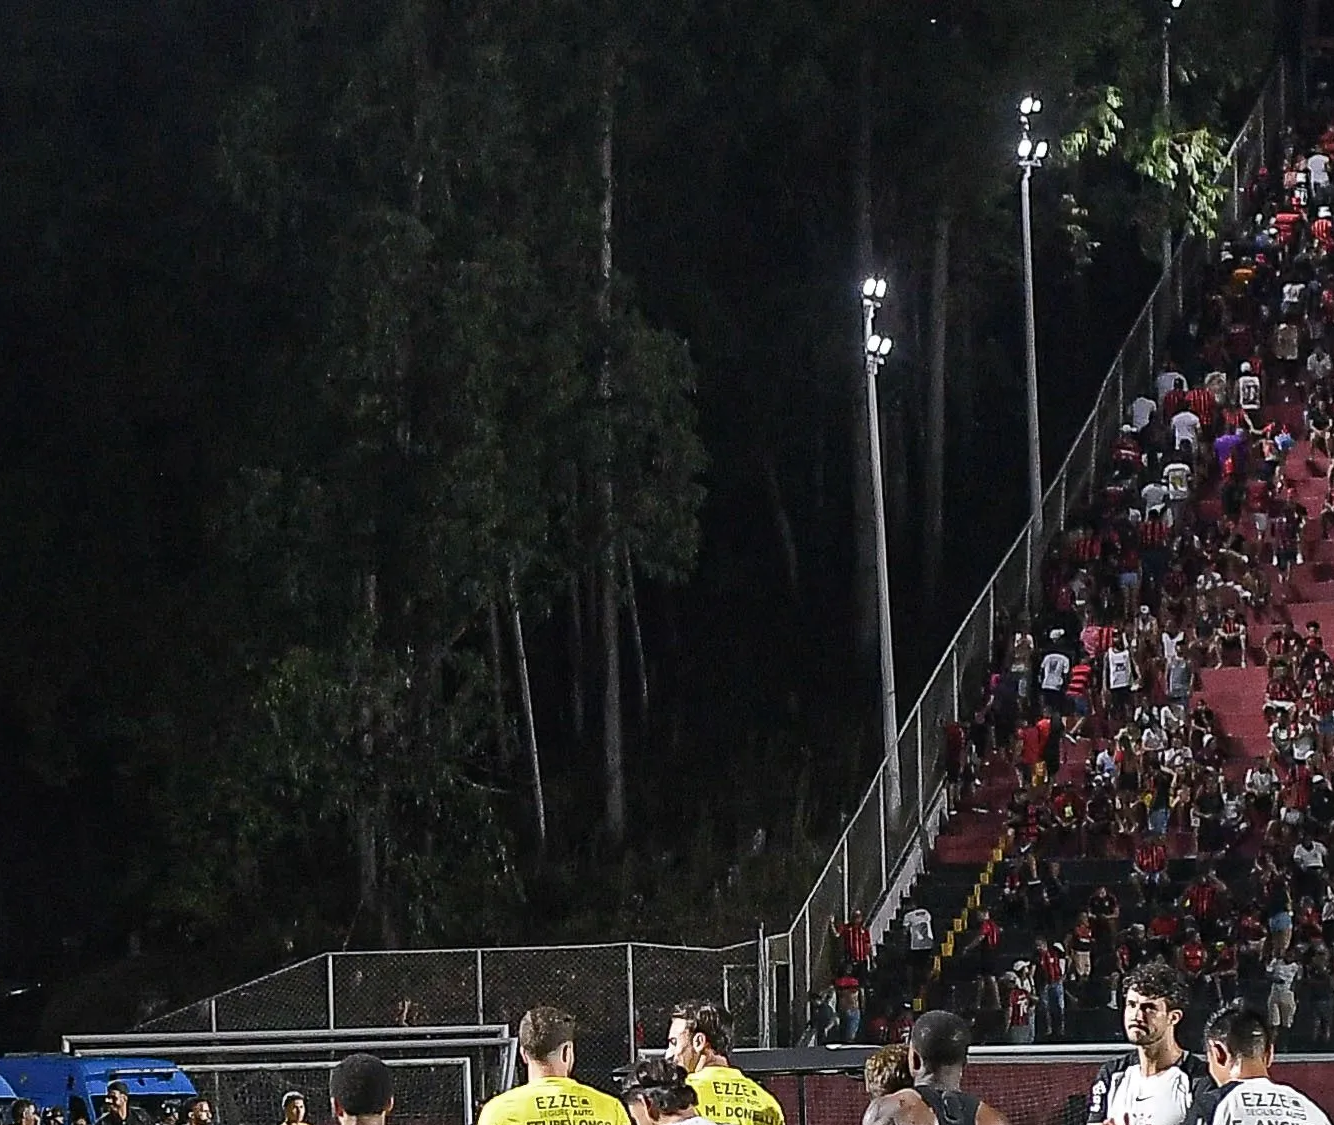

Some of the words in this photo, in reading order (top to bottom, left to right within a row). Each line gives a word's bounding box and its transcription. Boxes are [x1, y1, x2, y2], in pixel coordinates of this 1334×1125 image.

[713, 1081, 751, 1097] EZZE
[536, 1095, 580, 1109] EZZE
[1240, 1092, 1290, 1108] EZZE
